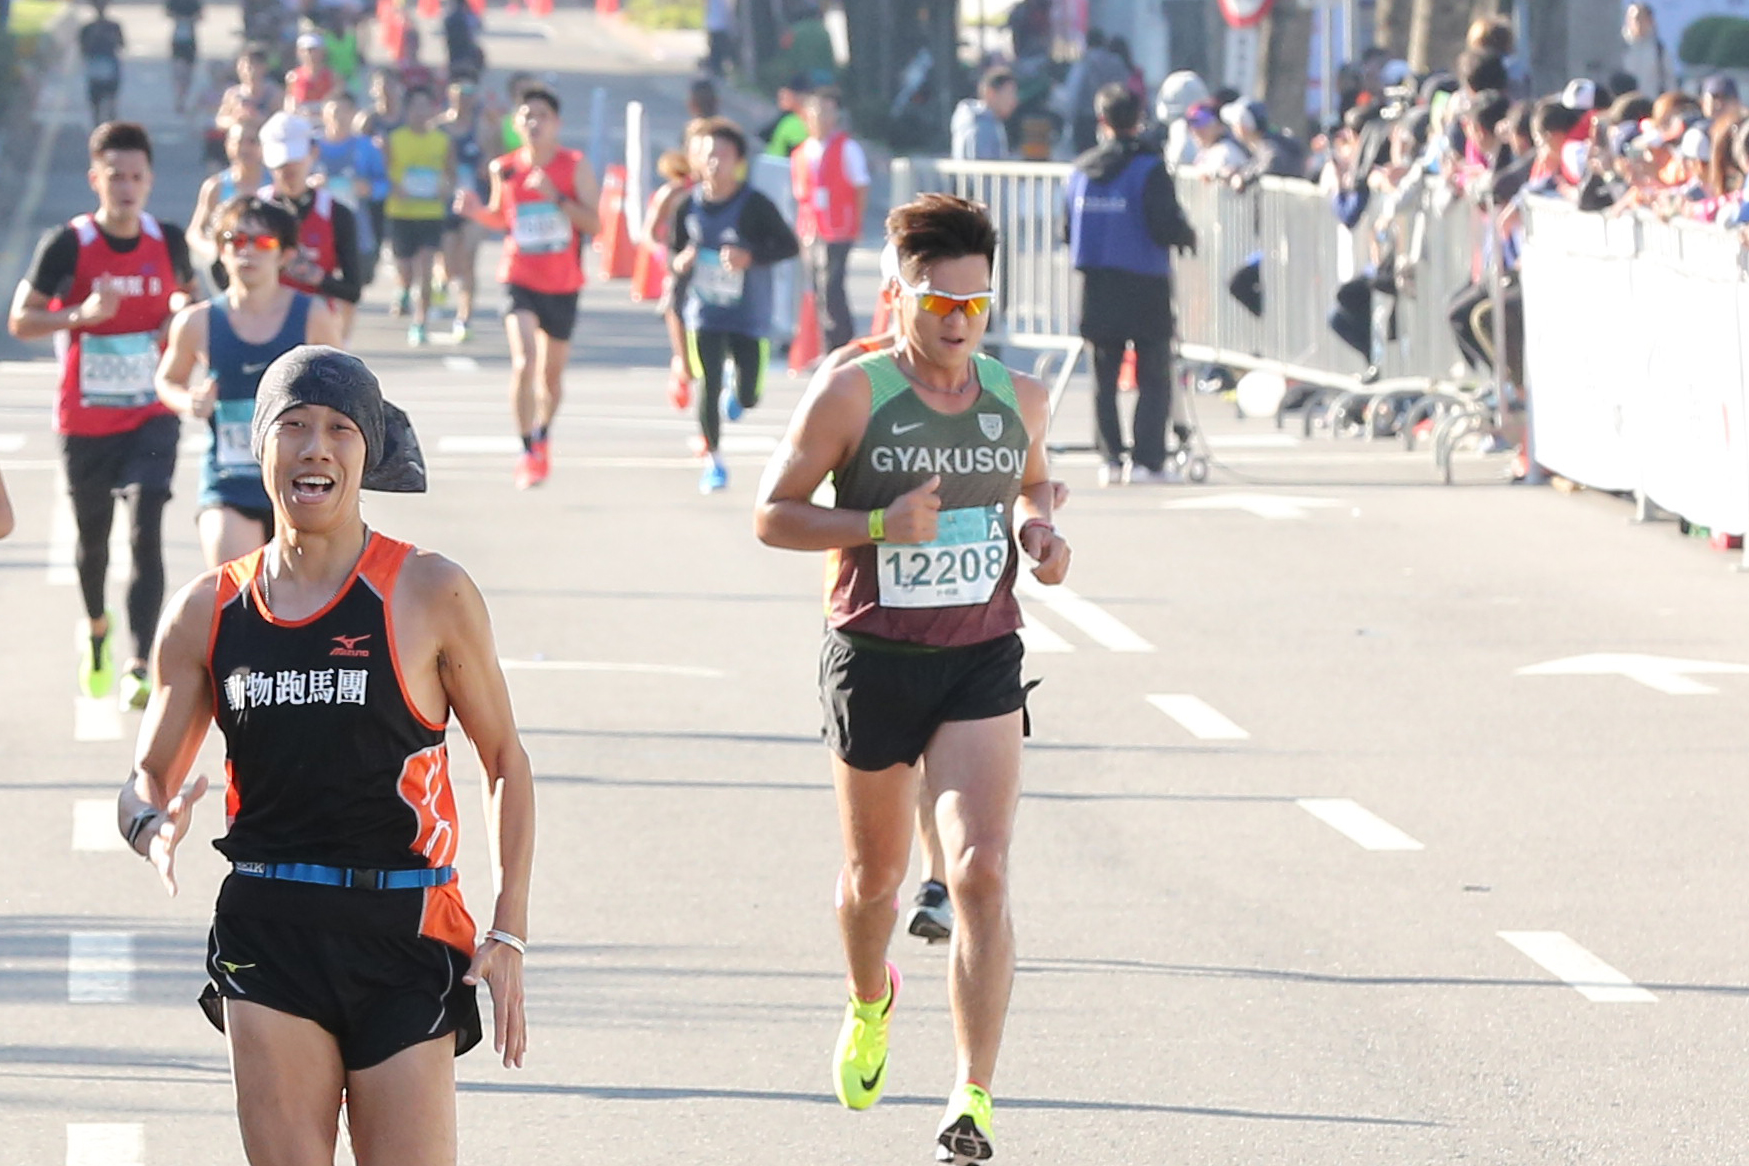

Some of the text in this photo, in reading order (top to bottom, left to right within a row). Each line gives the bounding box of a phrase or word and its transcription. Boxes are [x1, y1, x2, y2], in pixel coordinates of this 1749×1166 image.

[988, 520, 1003, 539] A
[884, 545, 1003, 586] 12208
[224, 668, 369, 711] 動物跑馬團
